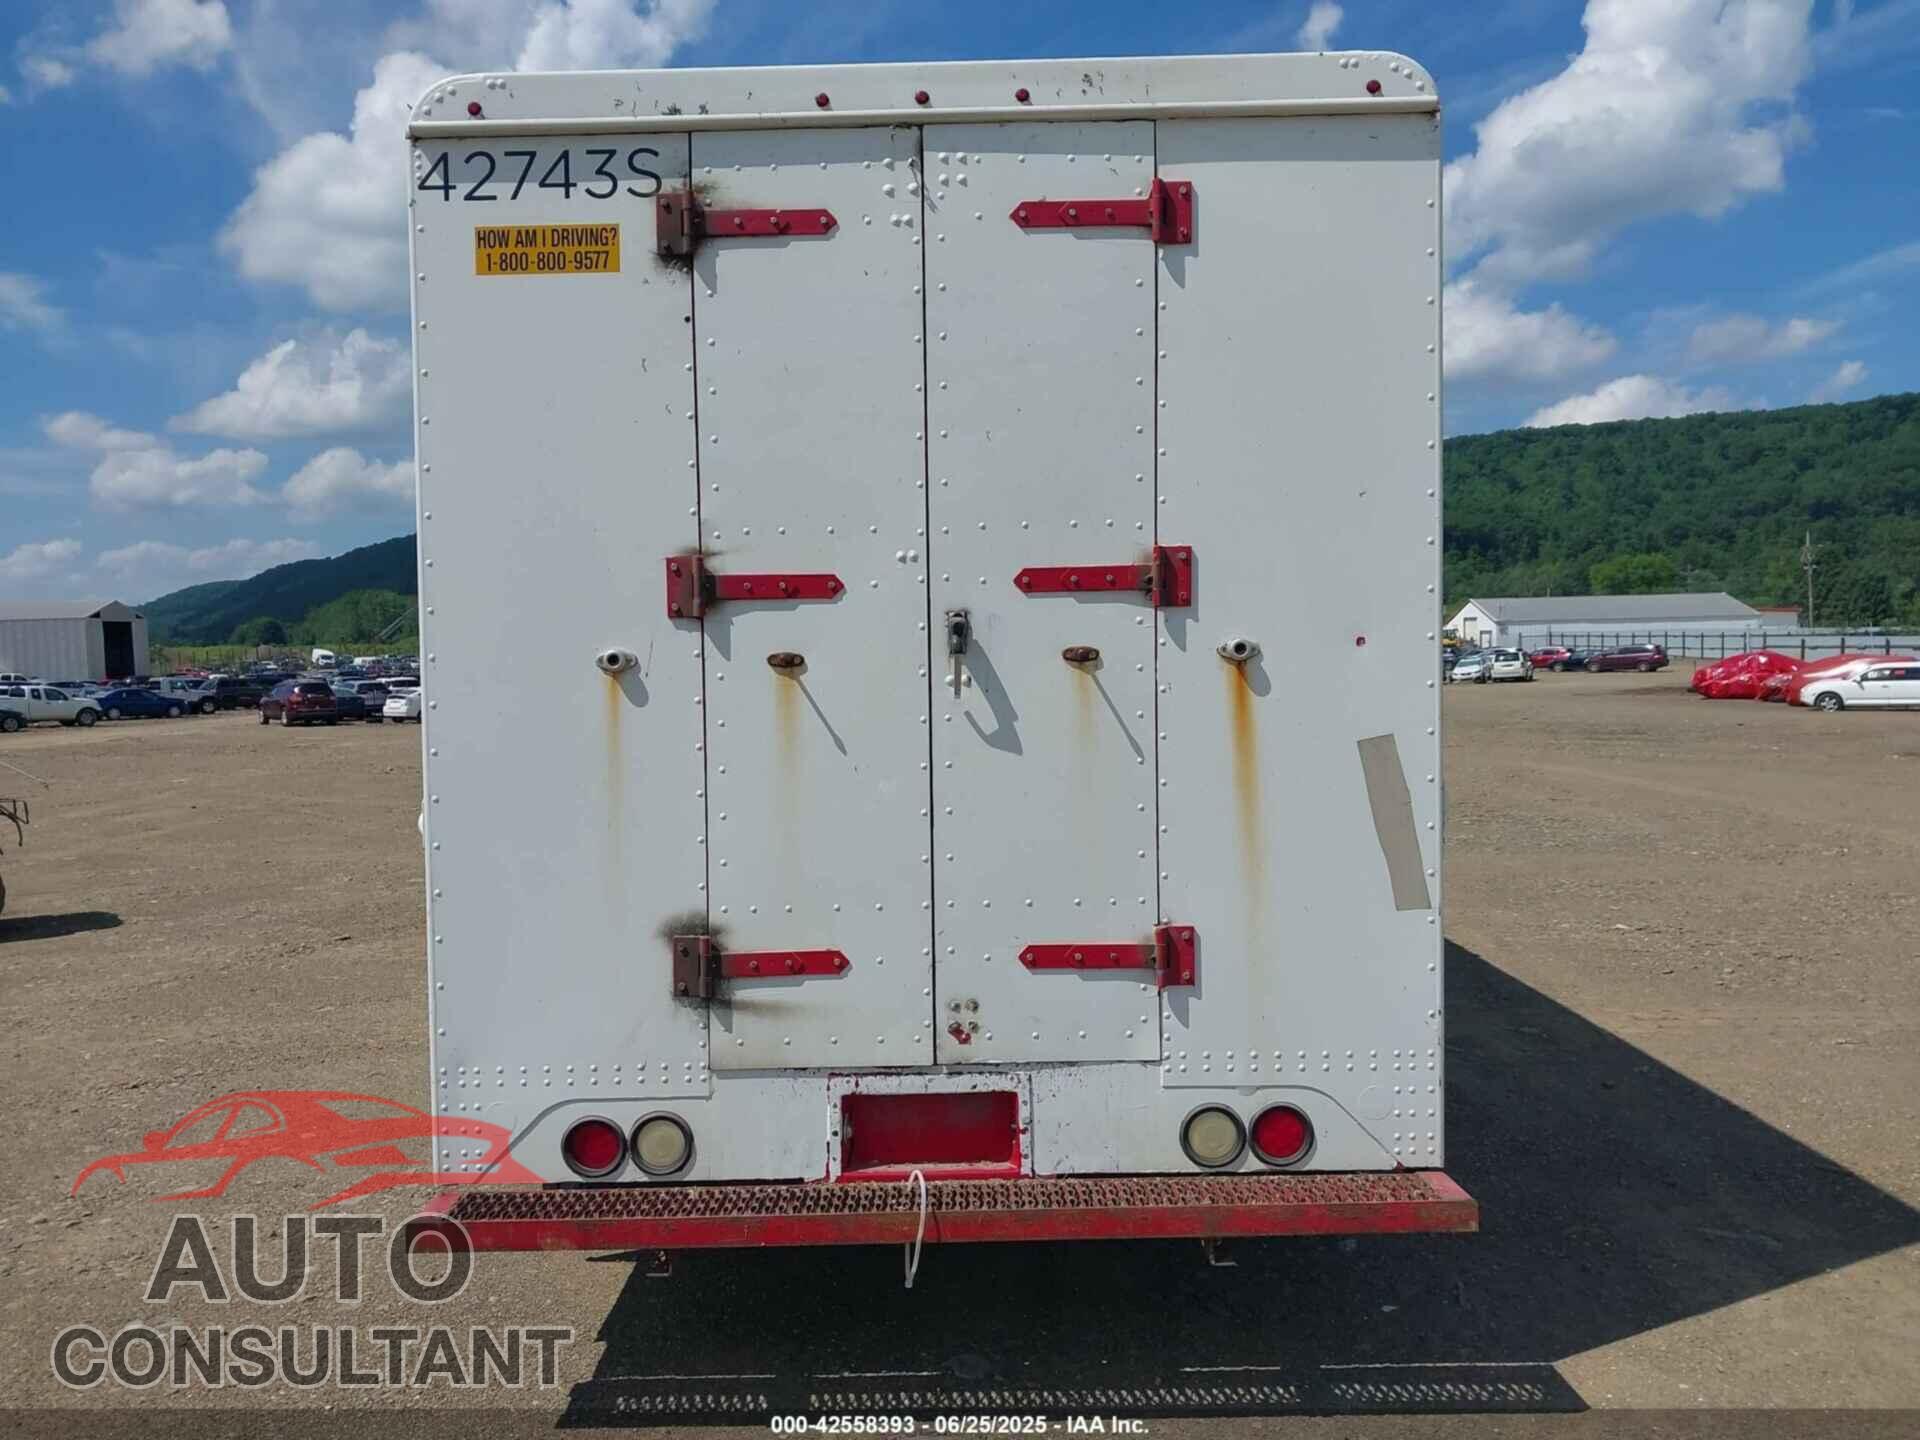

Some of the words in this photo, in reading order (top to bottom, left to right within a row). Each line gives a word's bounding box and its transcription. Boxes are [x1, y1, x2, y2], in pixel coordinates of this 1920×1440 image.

[418, 148, 662, 201] 42743S
[477, 229, 510, 249] HOW
[515, 229, 537, 248] AM
[541, 229, 547, 247] I
[552, 228, 617, 247] DRIVING?
[486, 251, 609, 271] 1-800-800-9577
